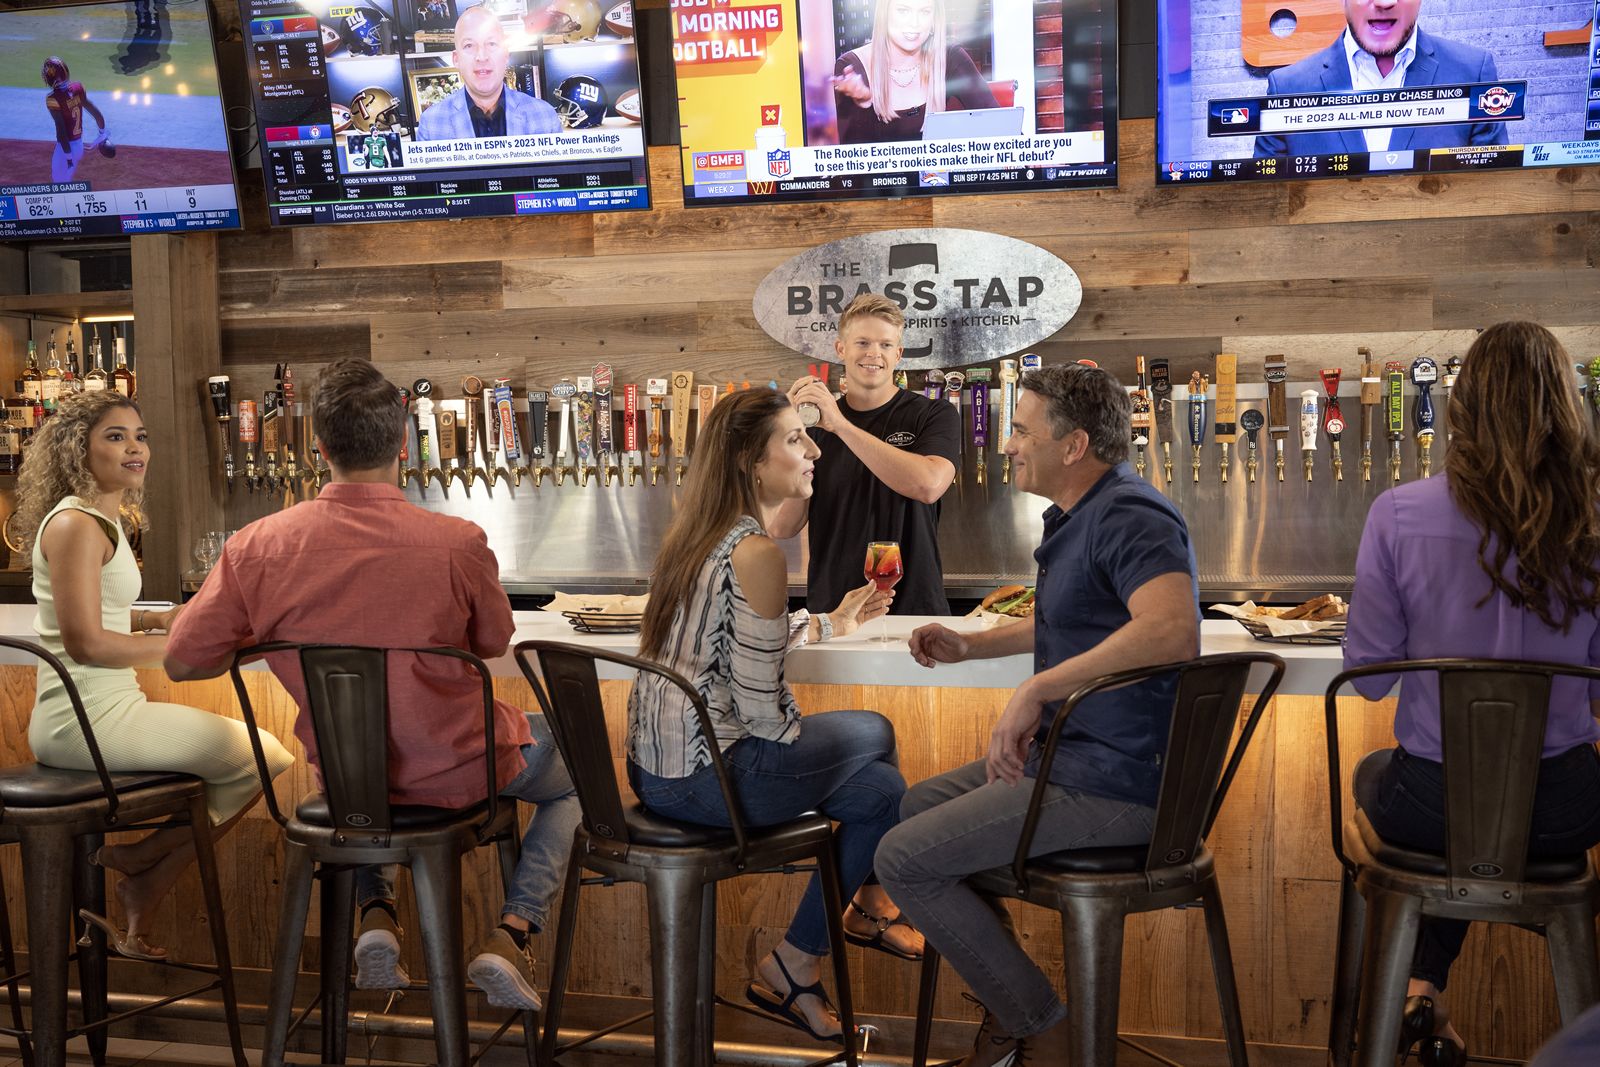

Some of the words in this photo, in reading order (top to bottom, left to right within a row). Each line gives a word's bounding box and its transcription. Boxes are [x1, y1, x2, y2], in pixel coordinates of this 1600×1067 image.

[681, 9, 779, 33] MORNING
[1268, 99, 1290, 109] MLB
[1294, 98, 1319, 107] NOW
[1322, 94, 1380, 105] PRESENTED
[1383, 93, 1397, 102] BY
[1399, 90, 1434, 101] CHASE
[1479, 93, 1516, 109] NOW
[1284, 115, 1303, 124] THE
[1307, 113, 1335, 123] 2023
[1338, 111, 1383, 121] ALL-MLB
[1387, 109, 1413, 118] NOW
[1417, 107, 1445, 117] TEAM
[373, 146, 380, 156] 8
[408, 146, 423, 155] Jets
[425, 144, 452, 153] ranked
[454, 142, 472, 151] 12th
[475, 142, 482, 150] in
[484, 139, 513, 150] ESPN's
[515, 139, 536, 148] 2023
[538, 137, 554, 146] NFL
[556, 136, 581, 145] Power
[582, 134, 620, 145] Rankings
[814, 150, 832, 160] The
[835, 148, 869, 159] Rookie
[871, 144, 927, 157] Excitement
[930, 143, 966, 154] Scales:
[969, 141, 991, 152] How
[994, 139, 1031, 151] excited
[1034, 140, 1052, 149] are
[1054, 138, 1072, 150] you
[425, 156, 445, 164] games:
[476, 153, 502, 161] Cowboys,
[510, 150, 533, 159] Patriots,
[542, 149, 561, 157] Chiefs,
[570, 148, 595, 156] Broncos,
[603, 146, 623, 154] Eagles
[815, 163, 825, 173] to
[827, 163, 844, 172] see
[846, 160, 865, 171] this
[867, 159, 898, 172] year's
[901, 157, 938, 168] rookies
[940, 155, 969, 166] make
[971, 153, 994, 164] their
[997, 152, 1017, 163] NFL
[1019, 150, 1055, 162] debut?
[1189, 162, 1208, 170] CHC
[1256, 159, 1277, 167] +140
[1328, 155, 1349, 163] -115
[1534, 153, 1551, 163] BASE
[771, 161, 789, 175] NFL
[1058, 169, 1108, 178] NETWORK
[1189, 171, 1209, 179] HOU
[1256, 167, 1277, 175] -166
[1305, 165, 1317, 173] 7.5
[1328, 164, 1349, 172] -105
[780, 181, 831, 191] COMMANDERS
[842, 180, 853, 188] VS
[873, 177, 908, 186] BRONCOS
[953, 174, 966, 183] SUN
[967, 174, 978, 182] SEP
[979, 173, 986, 181] 17
[986, 173, 1000, 181] 4:25
[1001, 172, 1011, 180] PM
[2, 185, 51, 196] COMMANDERS
[52, 184, 59, 193] (8
[59, 183, 87, 192] GAMES)
[25, 197, 42, 205] COMP
[30, 205, 54, 217] 62%
[76, 202, 107, 216] 1,755
[135, 200, 148, 211] 11
[189, 197, 197, 209] 9
[518, 198, 542, 209] STEPHEN
[557, 197, 577, 207] WORLD
[378, 210, 392, 218] ERA)
[820, 262, 861, 278] THE
[954, 276, 1044, 310] TAP
[962, 315, 1020, 327] KITCHEN
[1392, 382, 1400, 395] ALL
[1392, 396, 1400, 410] DAY
[1392, 411, 1400, 424] IPA
